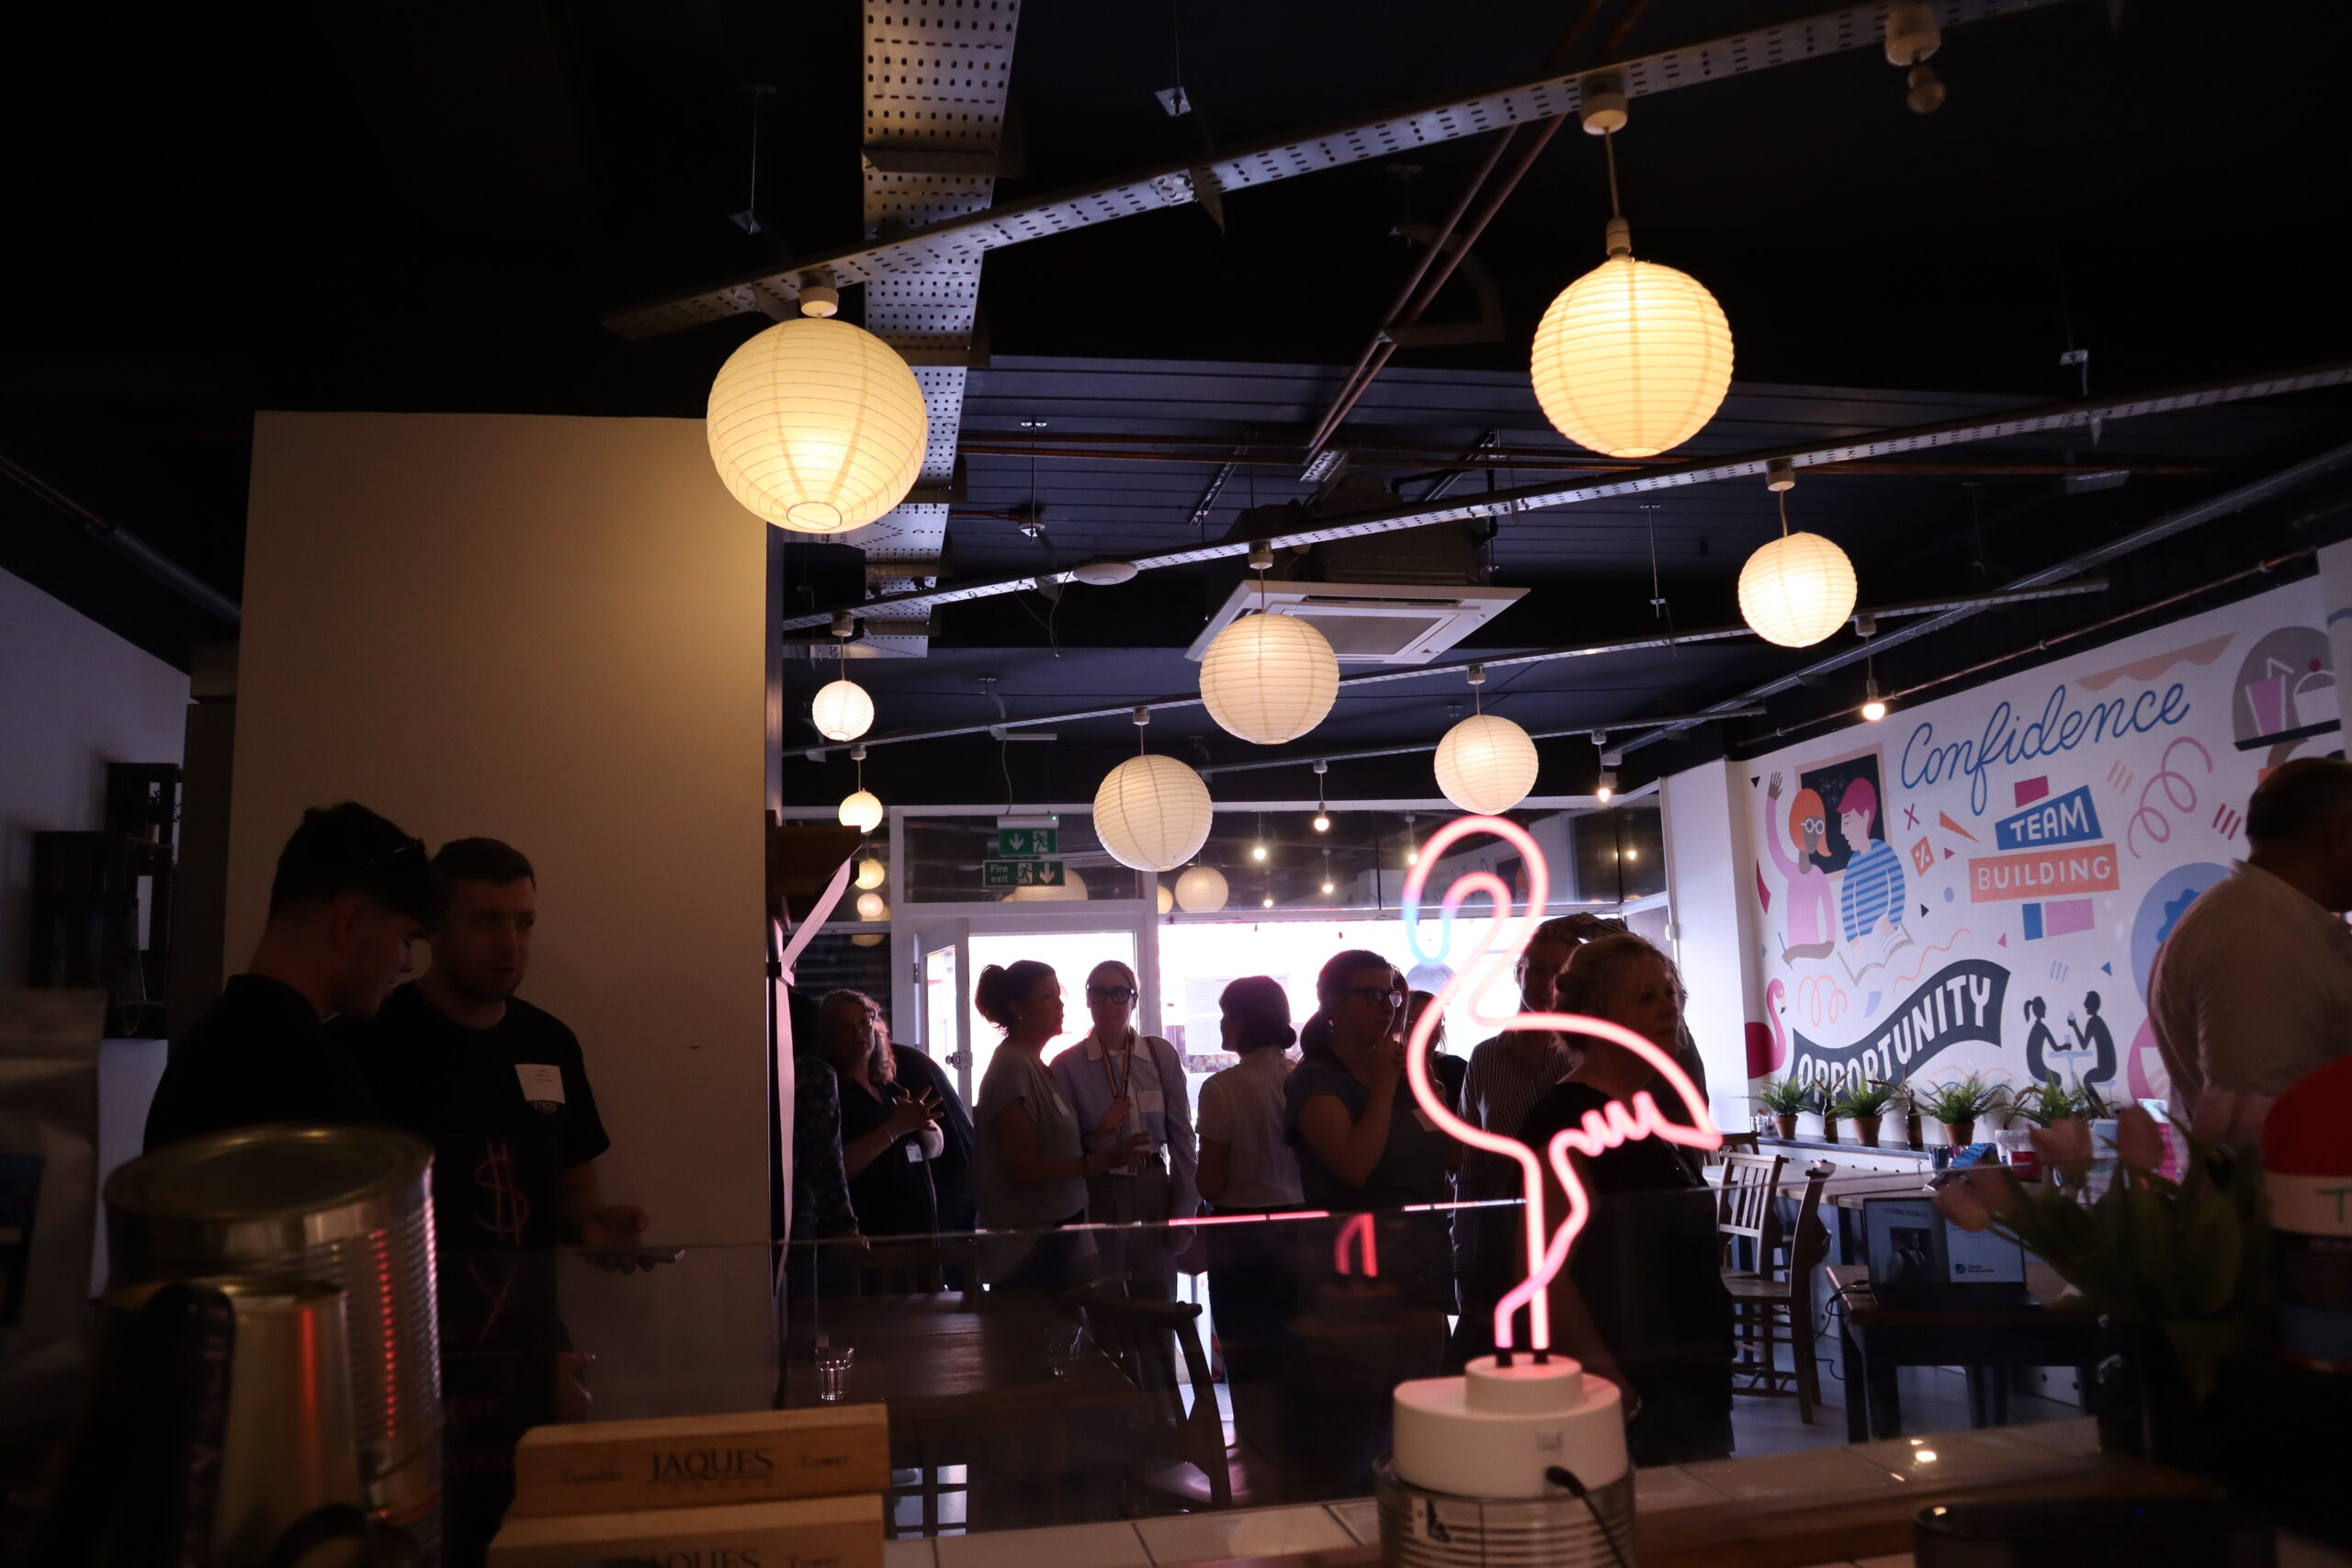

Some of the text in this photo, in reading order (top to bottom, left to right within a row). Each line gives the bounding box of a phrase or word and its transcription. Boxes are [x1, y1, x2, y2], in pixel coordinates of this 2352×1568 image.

[1901, 683, 2190, 817] Confidence
[2009, 795, 2090, 842] TEAM
[990, 864, 1009, 873] Fire
[990, 874, 1008, 883] exit
[1977, 855, 2111, 890] BUILDING
[1797, 974, 1992, 1104] OPPORTUNITY
[650, 1447, 774, 1483] JAQUES
[649, 1548, 762, 1568] QUES
